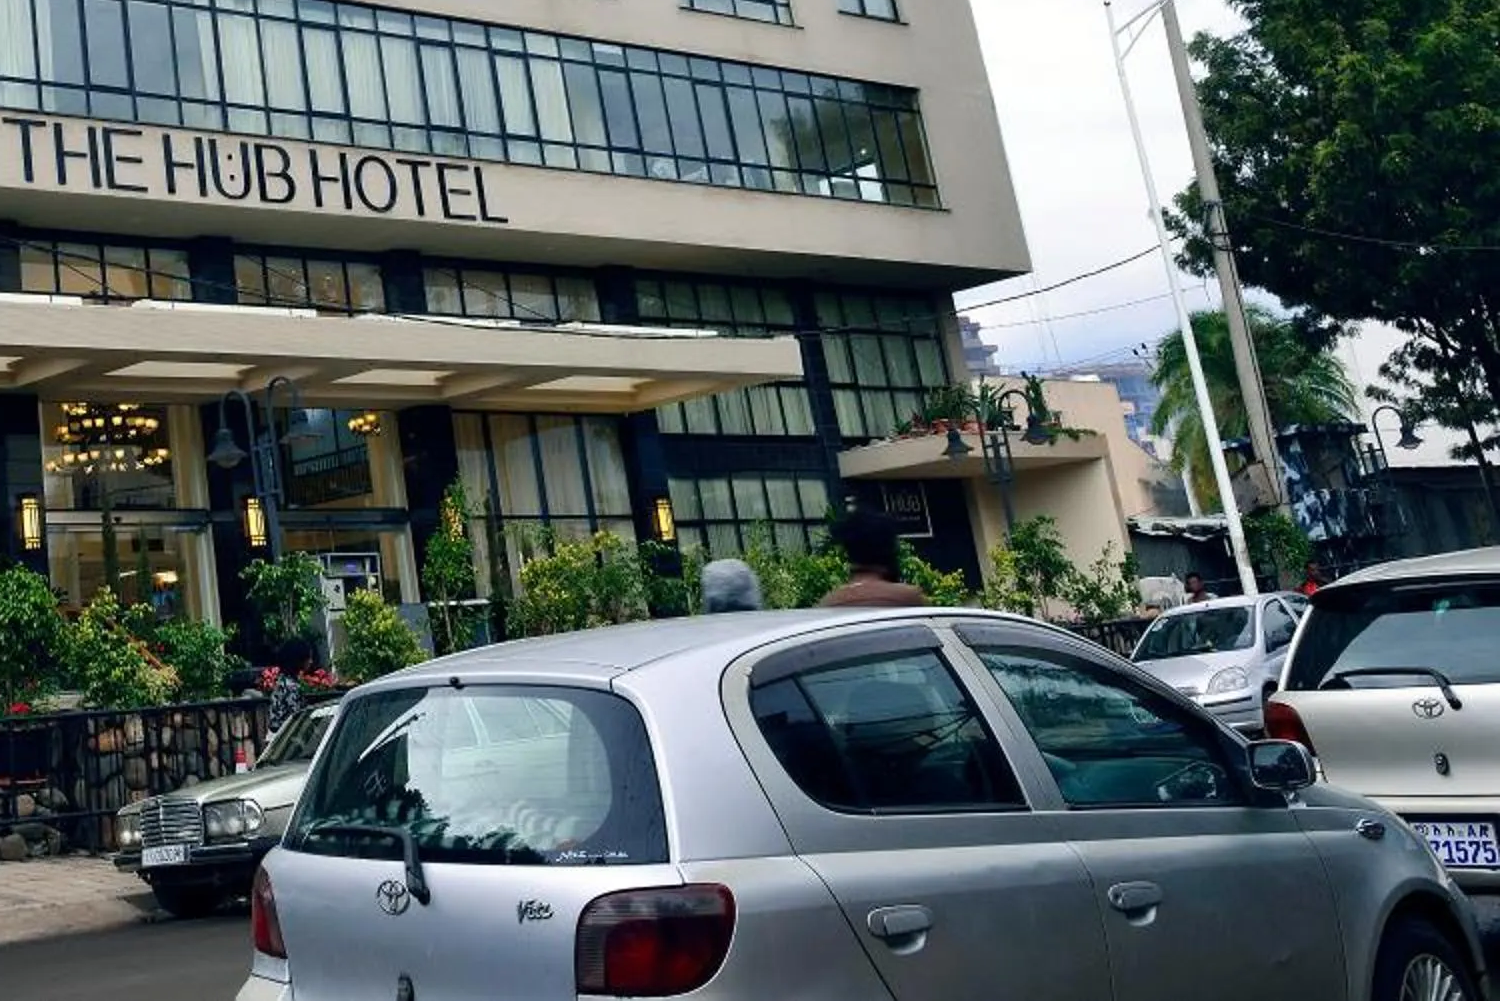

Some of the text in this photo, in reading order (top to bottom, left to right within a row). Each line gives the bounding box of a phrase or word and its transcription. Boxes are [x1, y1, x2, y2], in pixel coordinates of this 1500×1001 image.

[2, 116, 510, 224] THE HUB HOTEL
